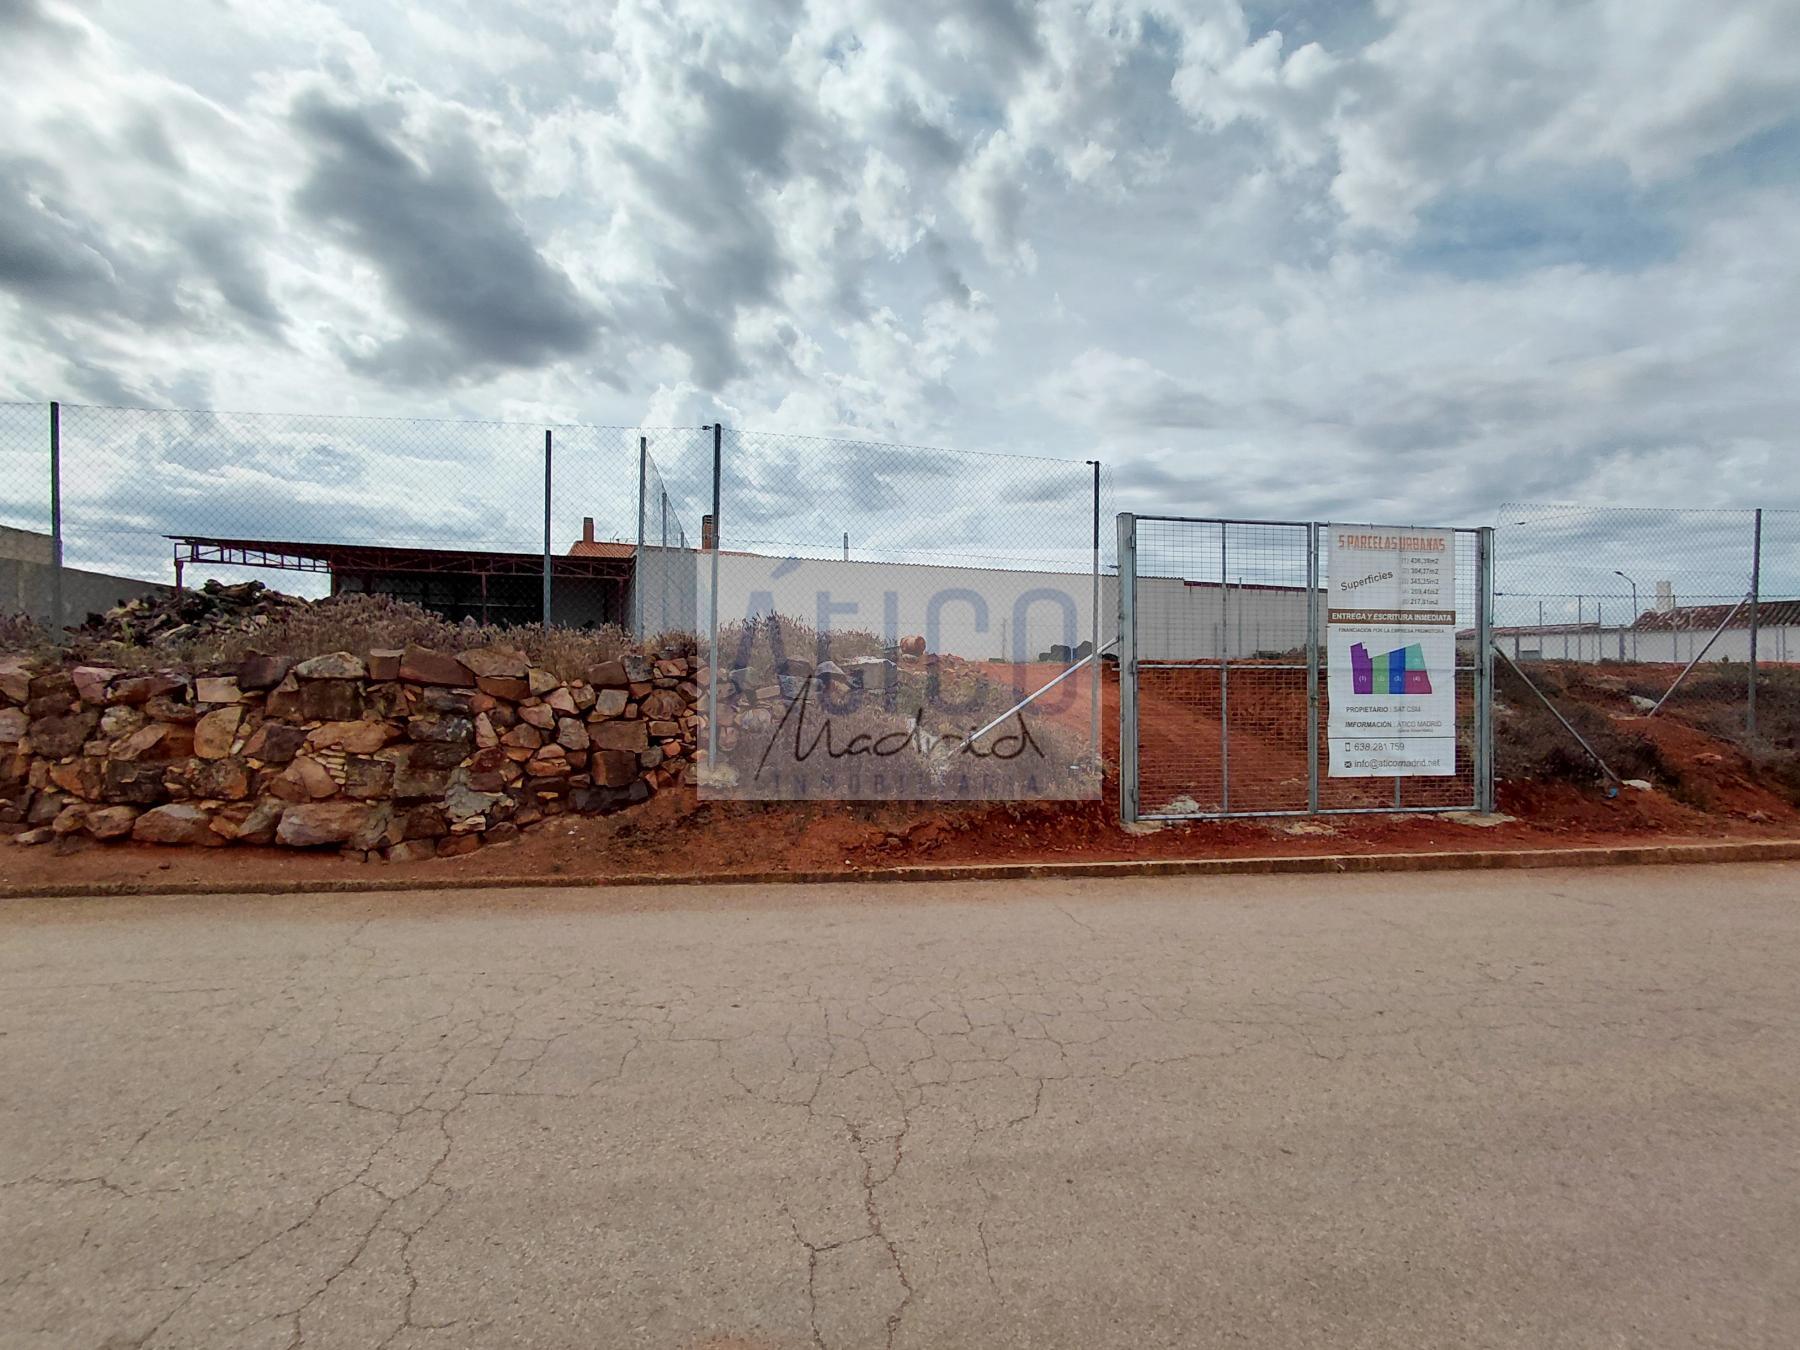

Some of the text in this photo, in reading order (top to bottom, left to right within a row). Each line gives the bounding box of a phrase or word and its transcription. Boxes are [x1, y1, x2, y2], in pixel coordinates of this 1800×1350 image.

[1338, 535, 1446, 552] 5 PARCELAS URBANAS
[1340, 570, 1394, 592] Superficies
[1331, 612, 1452, 622] ENTREGA Y ESCRITURA INMEDIATA
[1354, 758, 1441, 770] info@aticomadrid.net
